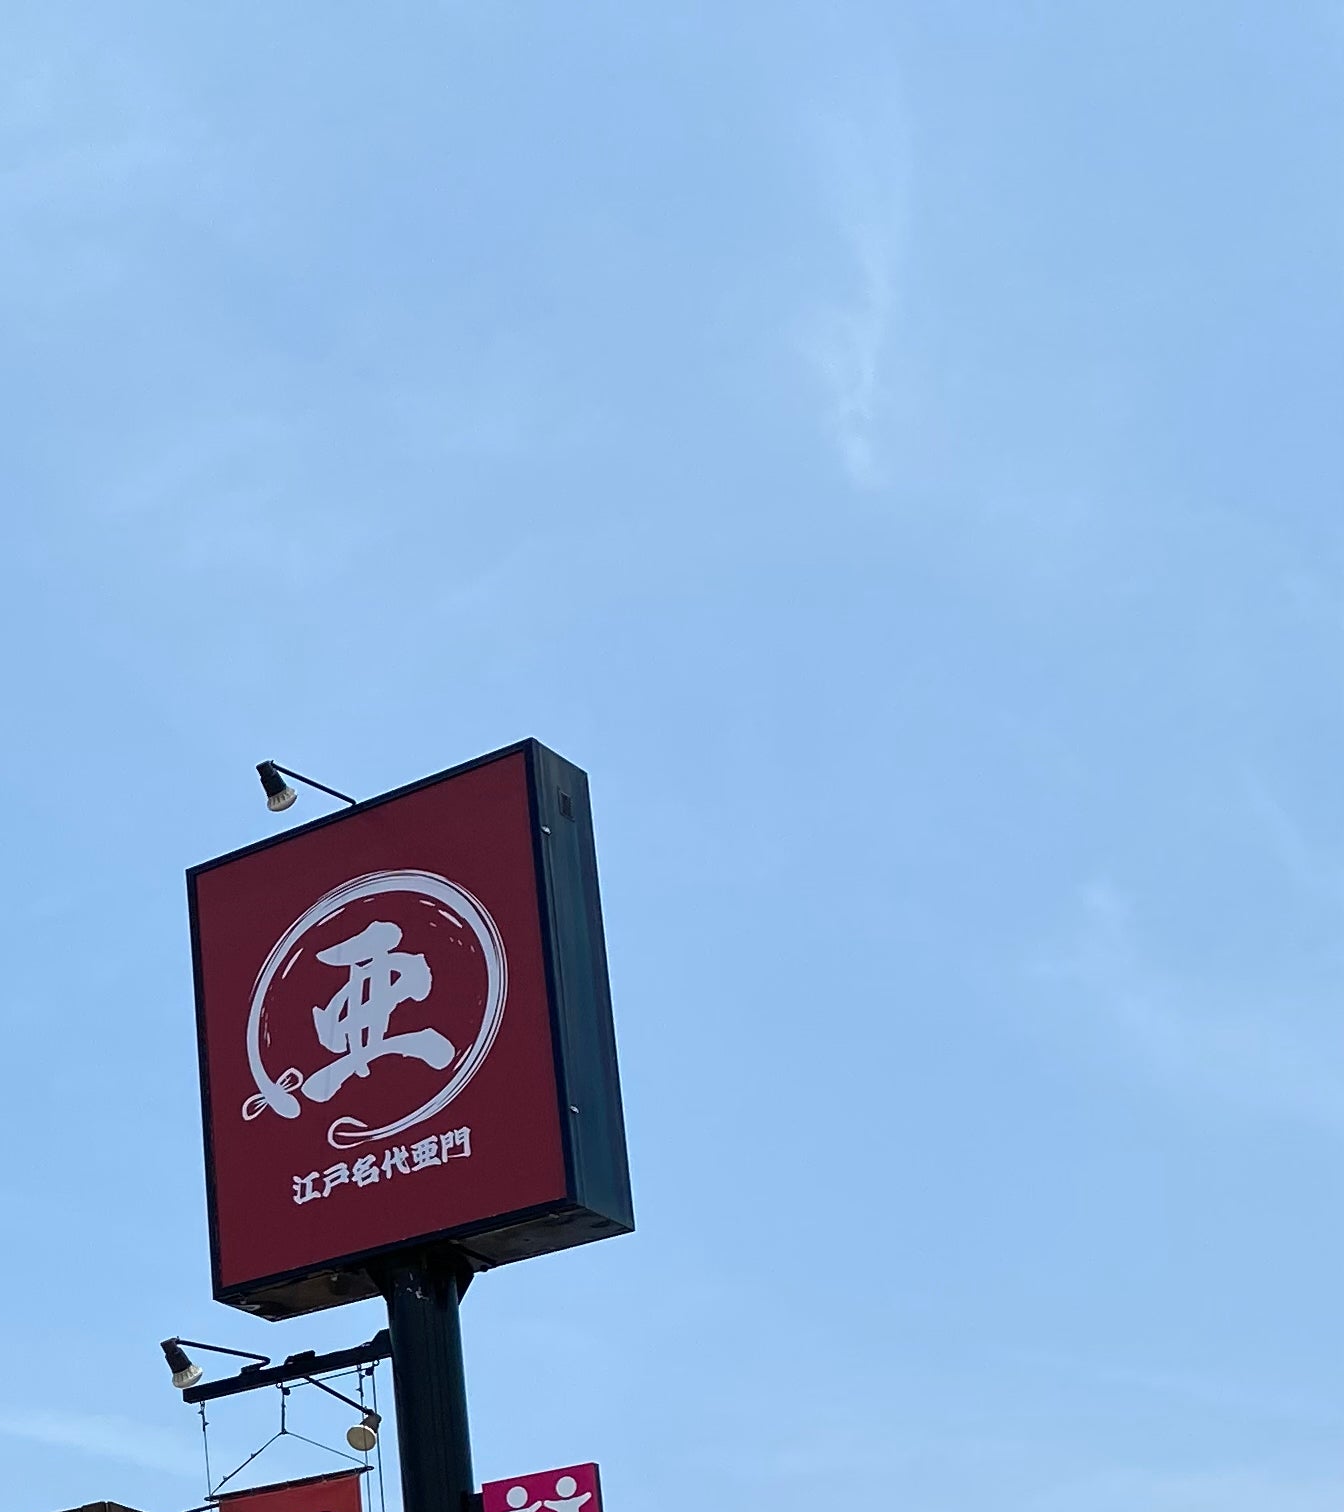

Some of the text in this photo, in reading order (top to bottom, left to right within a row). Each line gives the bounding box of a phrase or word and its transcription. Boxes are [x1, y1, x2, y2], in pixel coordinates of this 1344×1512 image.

[302, 921, 455, 1103] 亜
[292, 1126, 472, 1205] 江戸名代亜門
